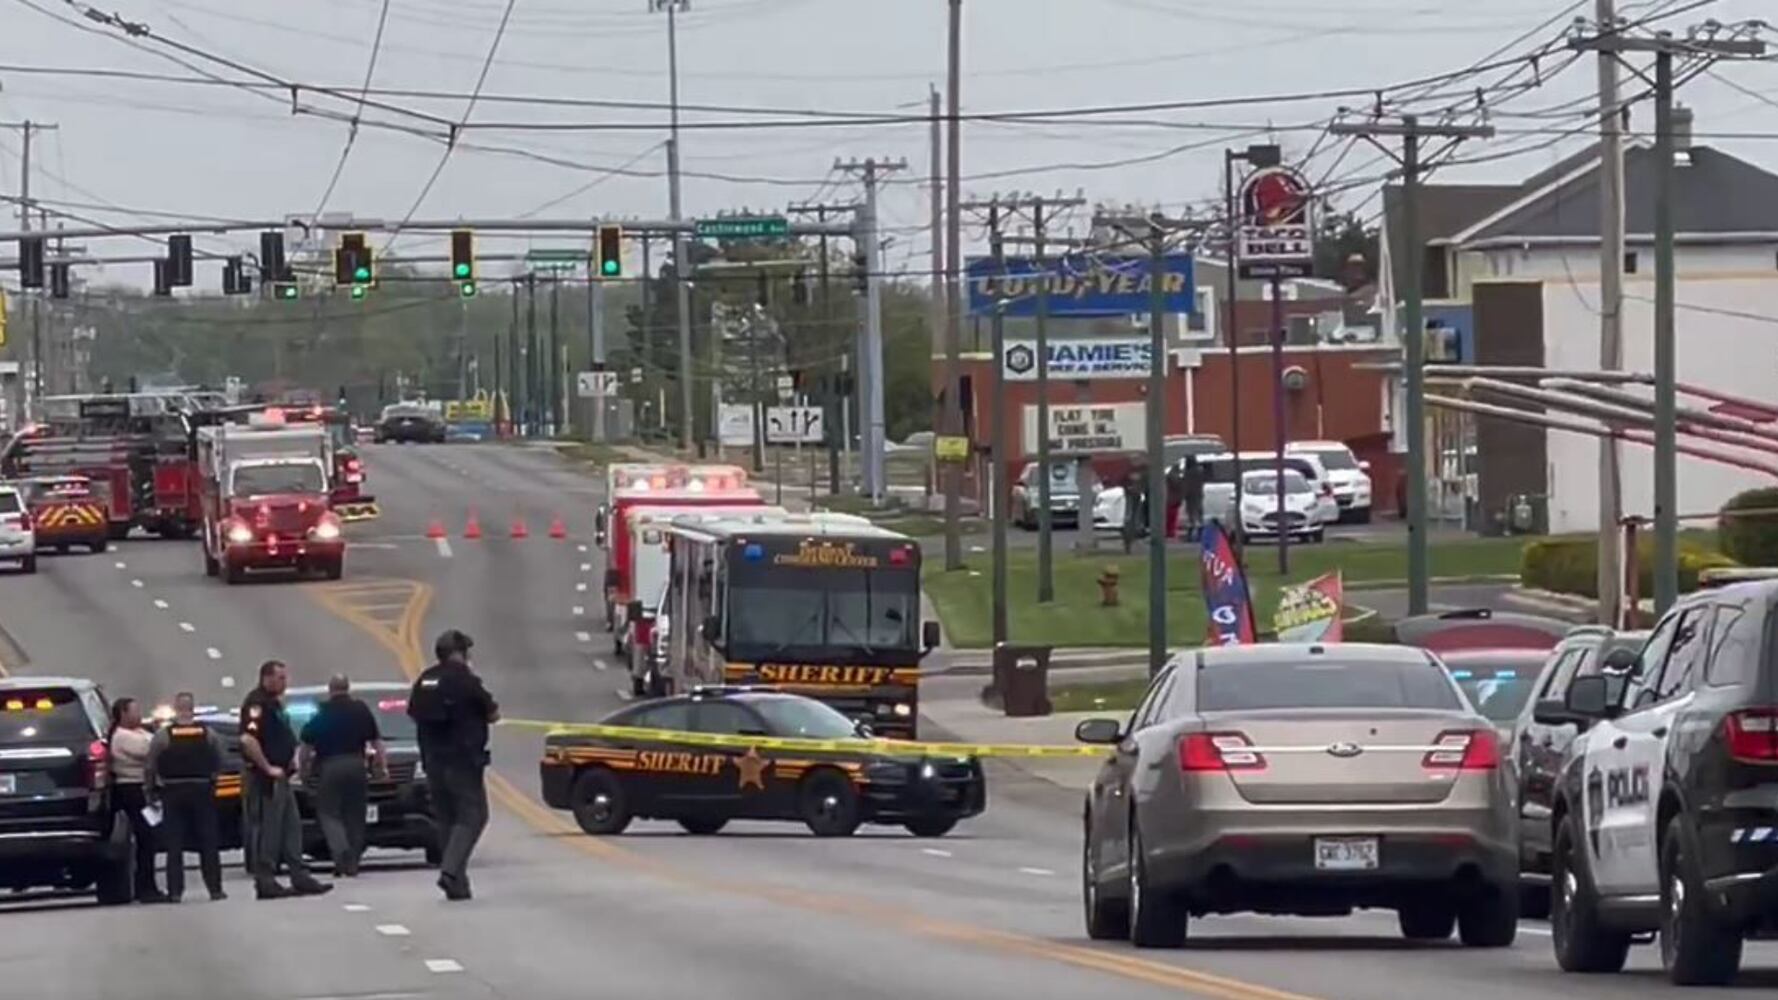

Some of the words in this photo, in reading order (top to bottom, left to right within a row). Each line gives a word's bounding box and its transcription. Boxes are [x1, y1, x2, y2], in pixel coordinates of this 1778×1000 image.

[1242, 228, 1306, 240] TACO
[1247, 243, 1308, 255] BELL
[760, 664, 889, 683] SHERIFF
[638, 751, 726, 774] SHERIFF
[1608, 767, 1650, 809] POLICE
